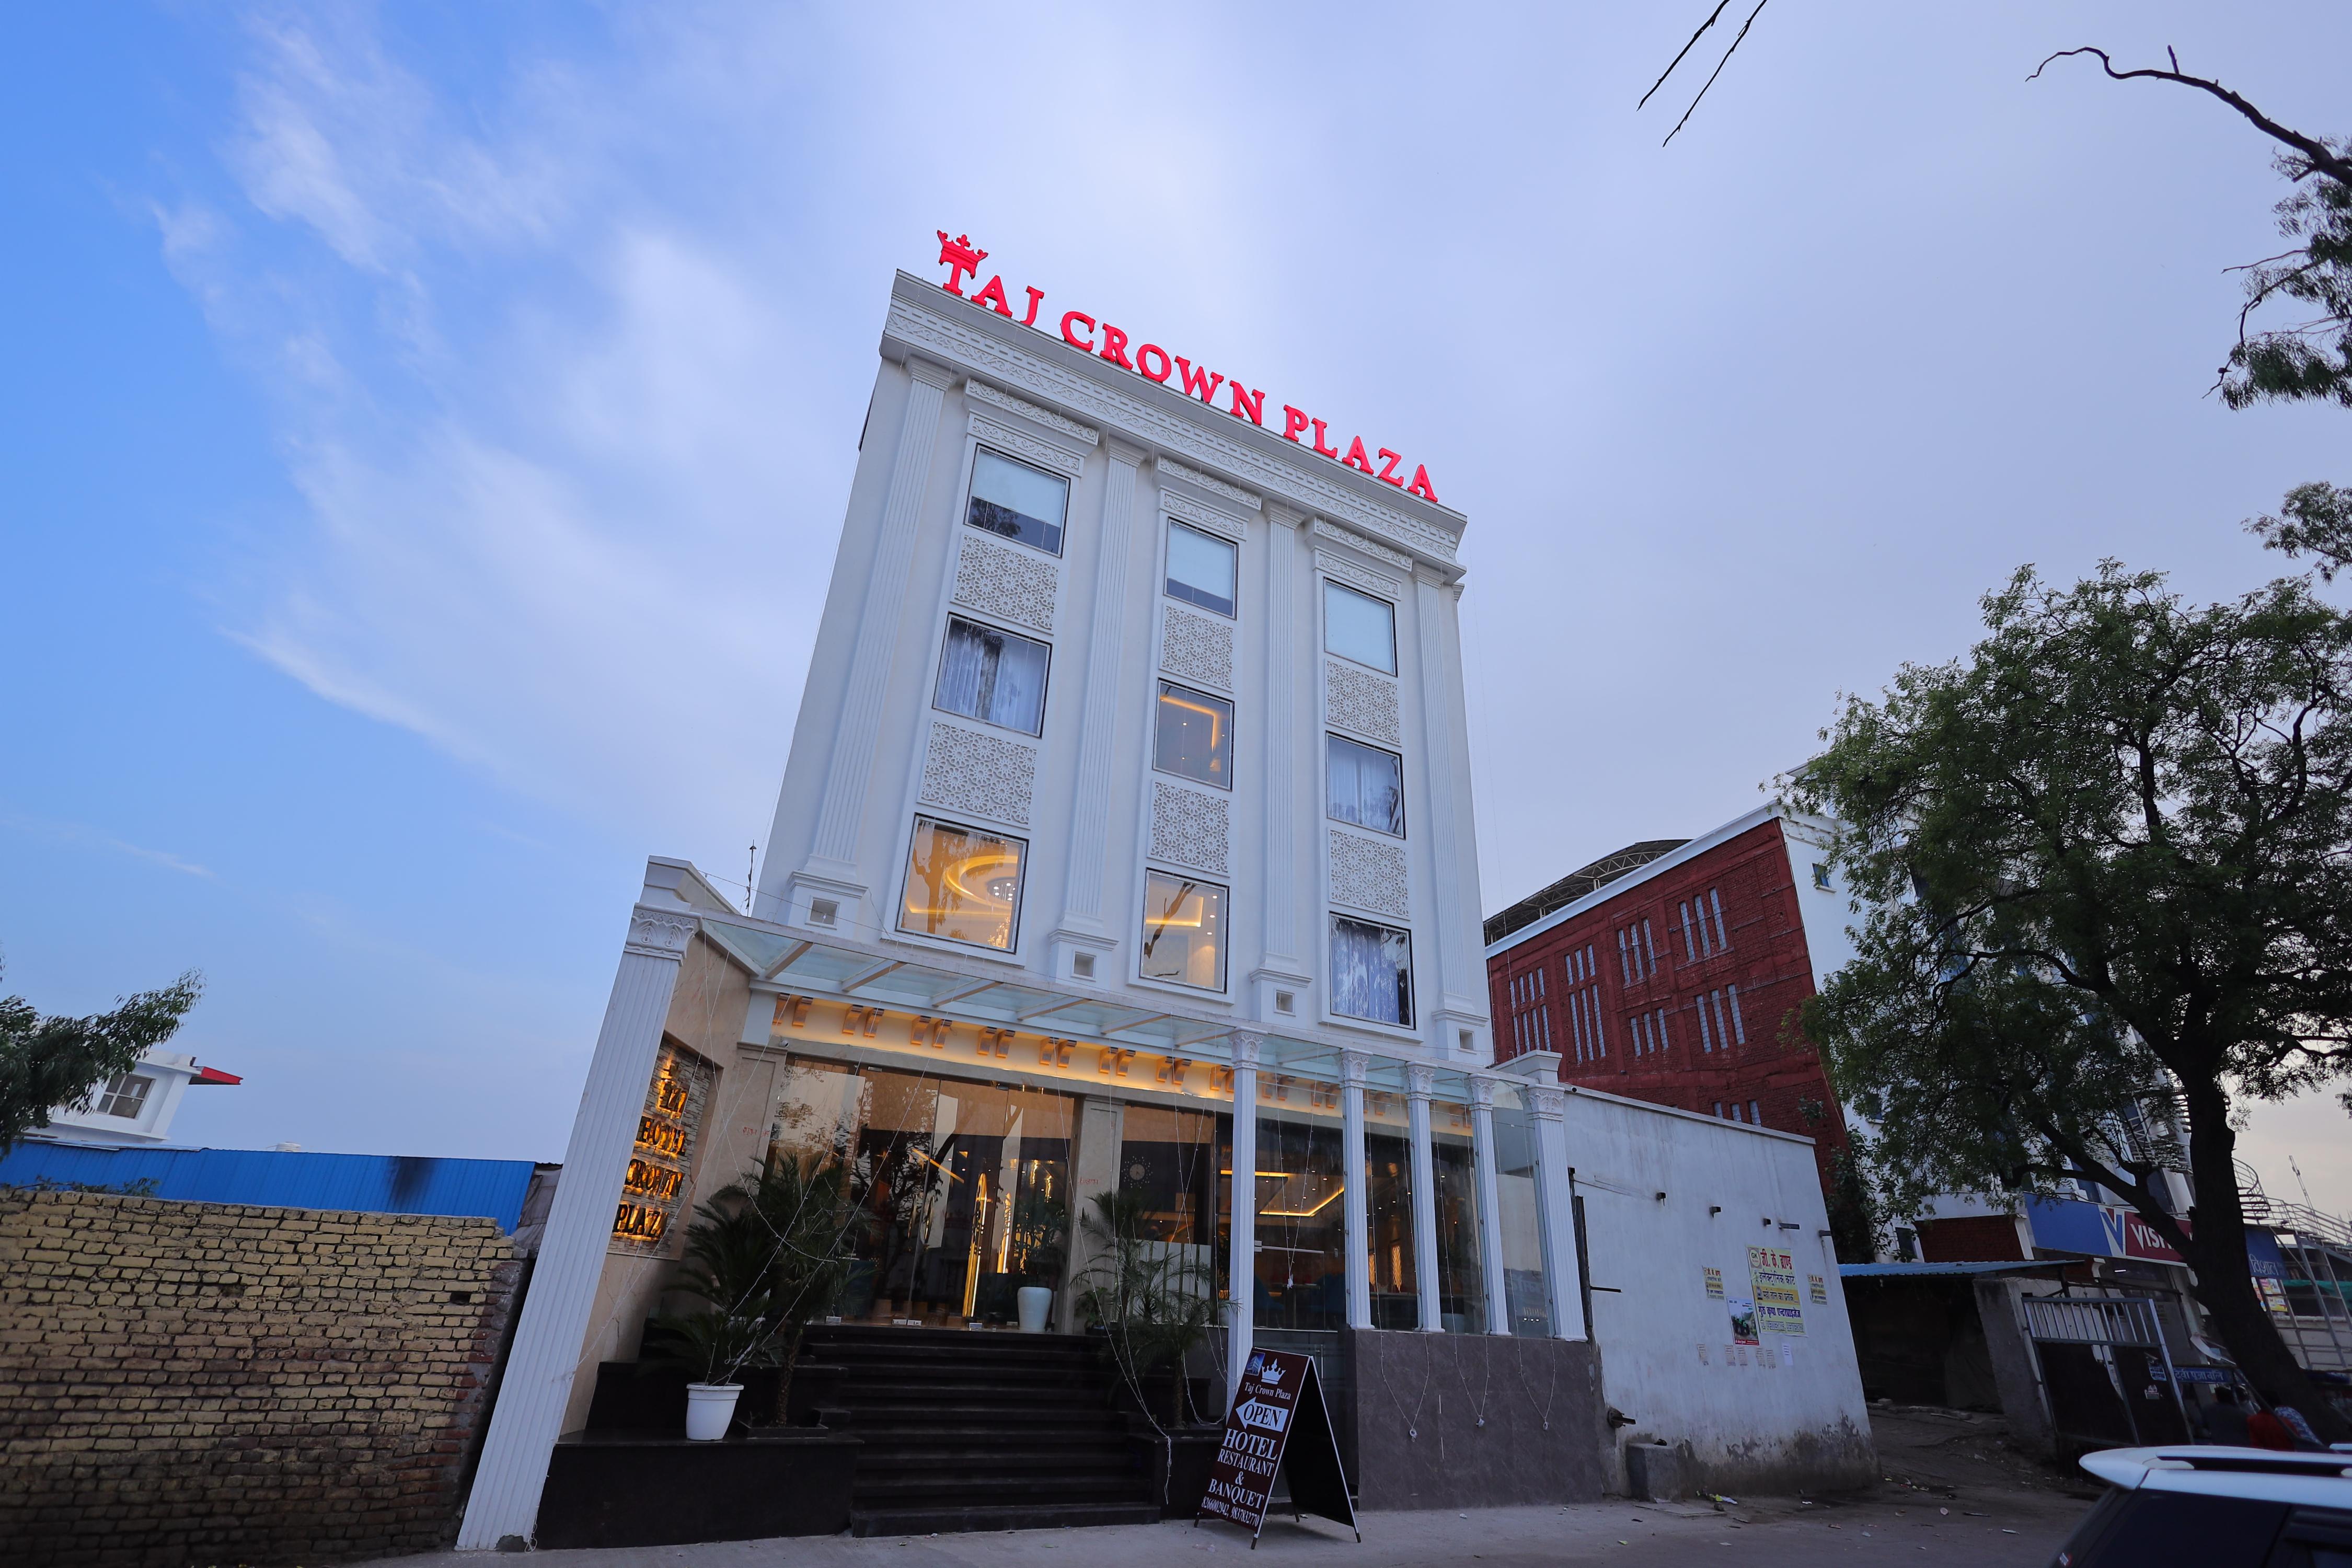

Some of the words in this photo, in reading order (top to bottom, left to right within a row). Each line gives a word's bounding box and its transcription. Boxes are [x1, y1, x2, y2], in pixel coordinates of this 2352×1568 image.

[938, 244, 1044, 327] TAJ
[1060, 310, 1265, 426] CROWN
[1283, 404, 1439, 503] PLAZA
[613, 1204, 669, 1240] PLAZA
[1244, 1382, 1255, 1394] Taj
[1255, 1385, 1275, 1397] Crown
[1275, 1388, 1292, 1400] Plaza
[1243, 1404, 1283, 1428] OPEN
[1221, 1428, 1278, 1460] HOTEL
[1217, 1449, 1274, 1477] RESTAURANT
[1235, 1471, 1245, 1485] &
[1208, 1478, 1265, 1509] BANQUET
